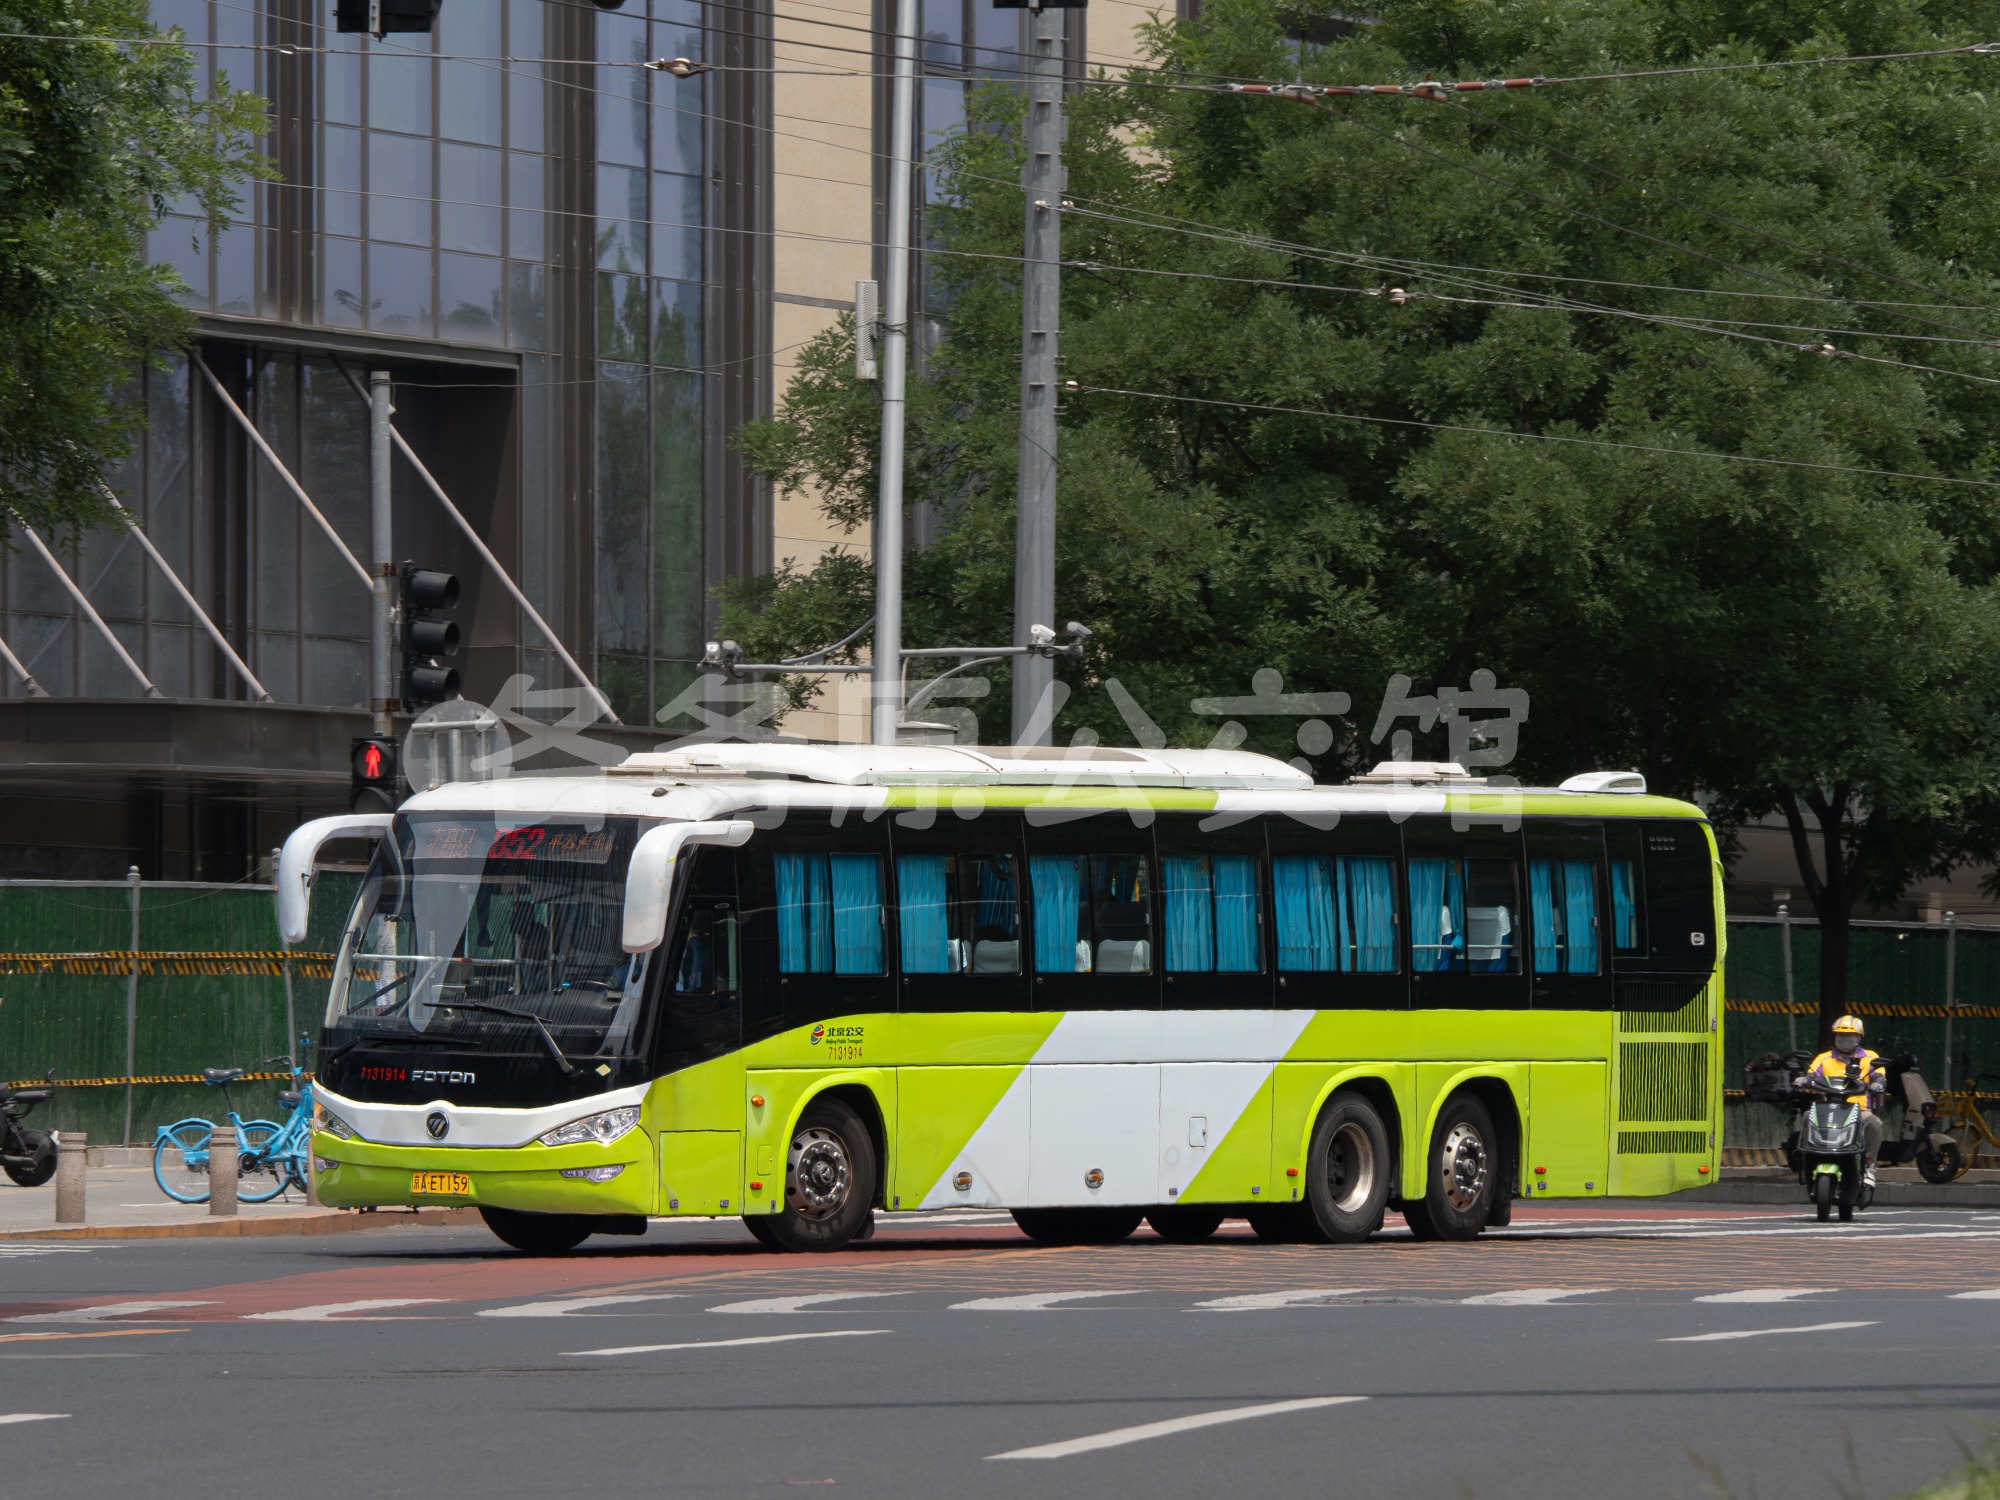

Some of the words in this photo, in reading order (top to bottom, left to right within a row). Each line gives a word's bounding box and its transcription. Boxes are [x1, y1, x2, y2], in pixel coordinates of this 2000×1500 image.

[430, 827, 477, 844] 东直门
[488, 828, 546, 859] 852
[827, 1027, 864, 1037] 北京公交
[828, 1046, 862, 1060] 7131914
[360, 1067, 406, 1082] 7131914
